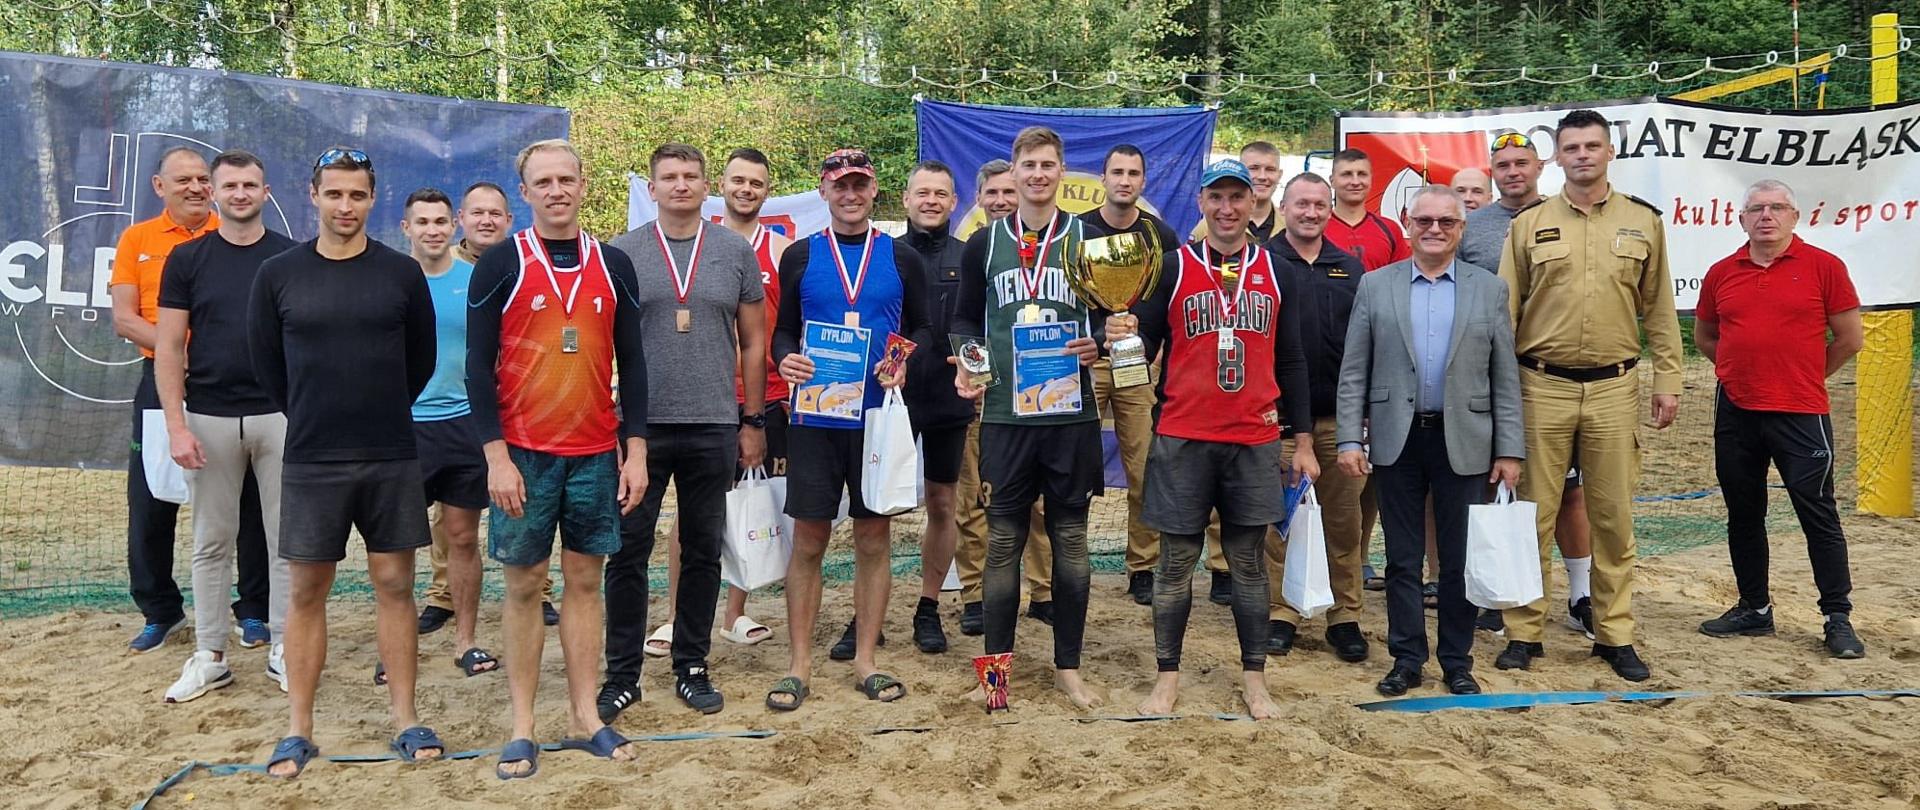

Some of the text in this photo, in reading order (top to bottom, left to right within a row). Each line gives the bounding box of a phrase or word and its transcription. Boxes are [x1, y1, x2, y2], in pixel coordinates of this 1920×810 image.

[1489, 117, 1697, 165] OIAT
[761, 271, 771, 284] 2
[1674, 277, 1704, 297] po
[1, 303, 24, 316] W
[593, 296, 602, 314] 1
[821, 328, 854, 344] DYPLOM
[1029, 327, 1062, 342] DYPLOM
[1217, 336, 1245, 393] 8
[772, 456, 787, 476] 13
